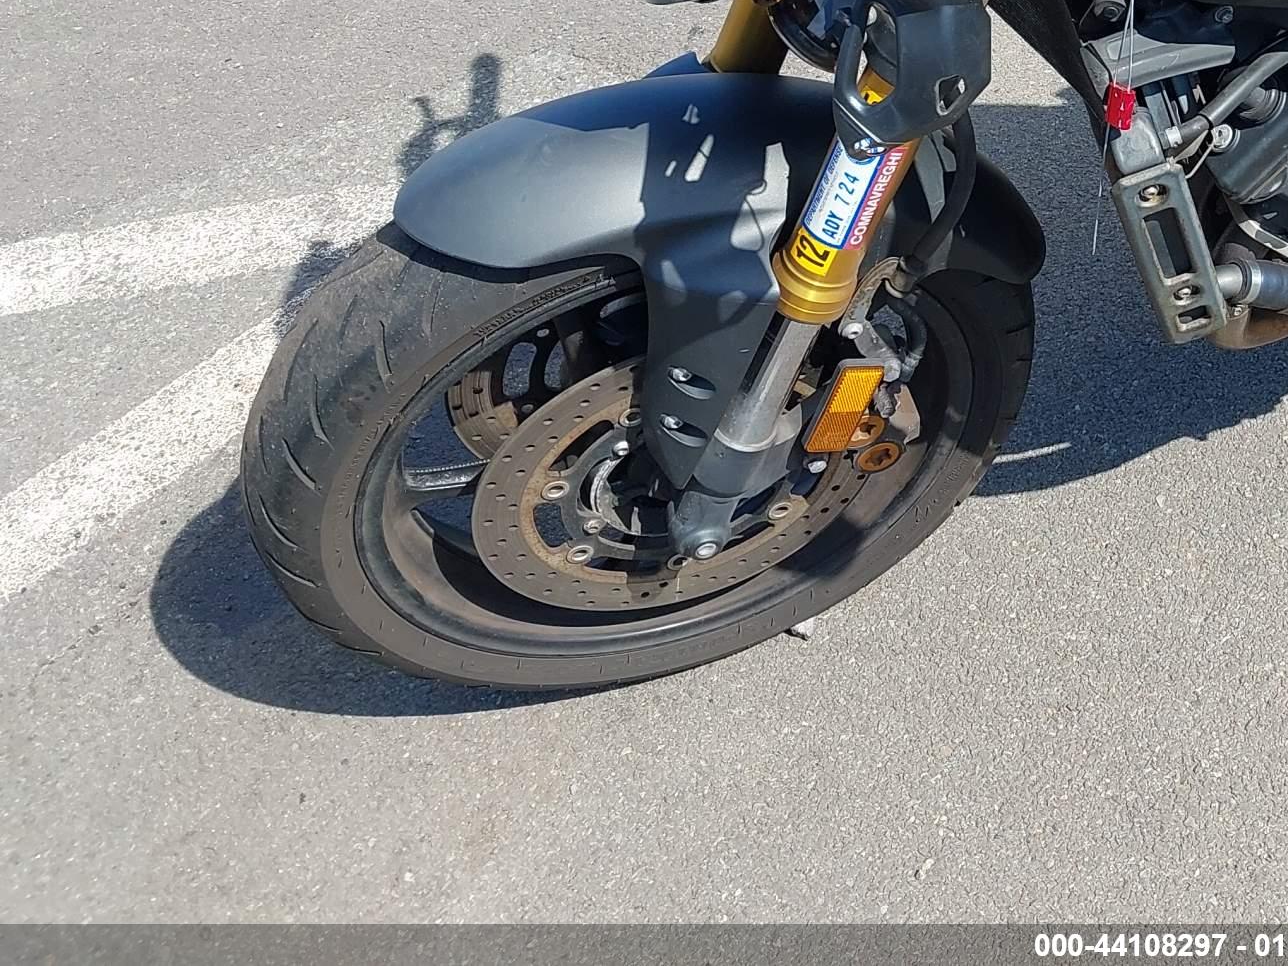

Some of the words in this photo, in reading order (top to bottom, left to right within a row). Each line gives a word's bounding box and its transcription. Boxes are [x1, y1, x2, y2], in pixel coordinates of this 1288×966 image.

[803, 184, 826, 225] DEPARTMENT
[821, 173, 830, 185] OF
[849, 152, 903, 243] COMNAVREGHI
[796, 234, 830, 266] 12
